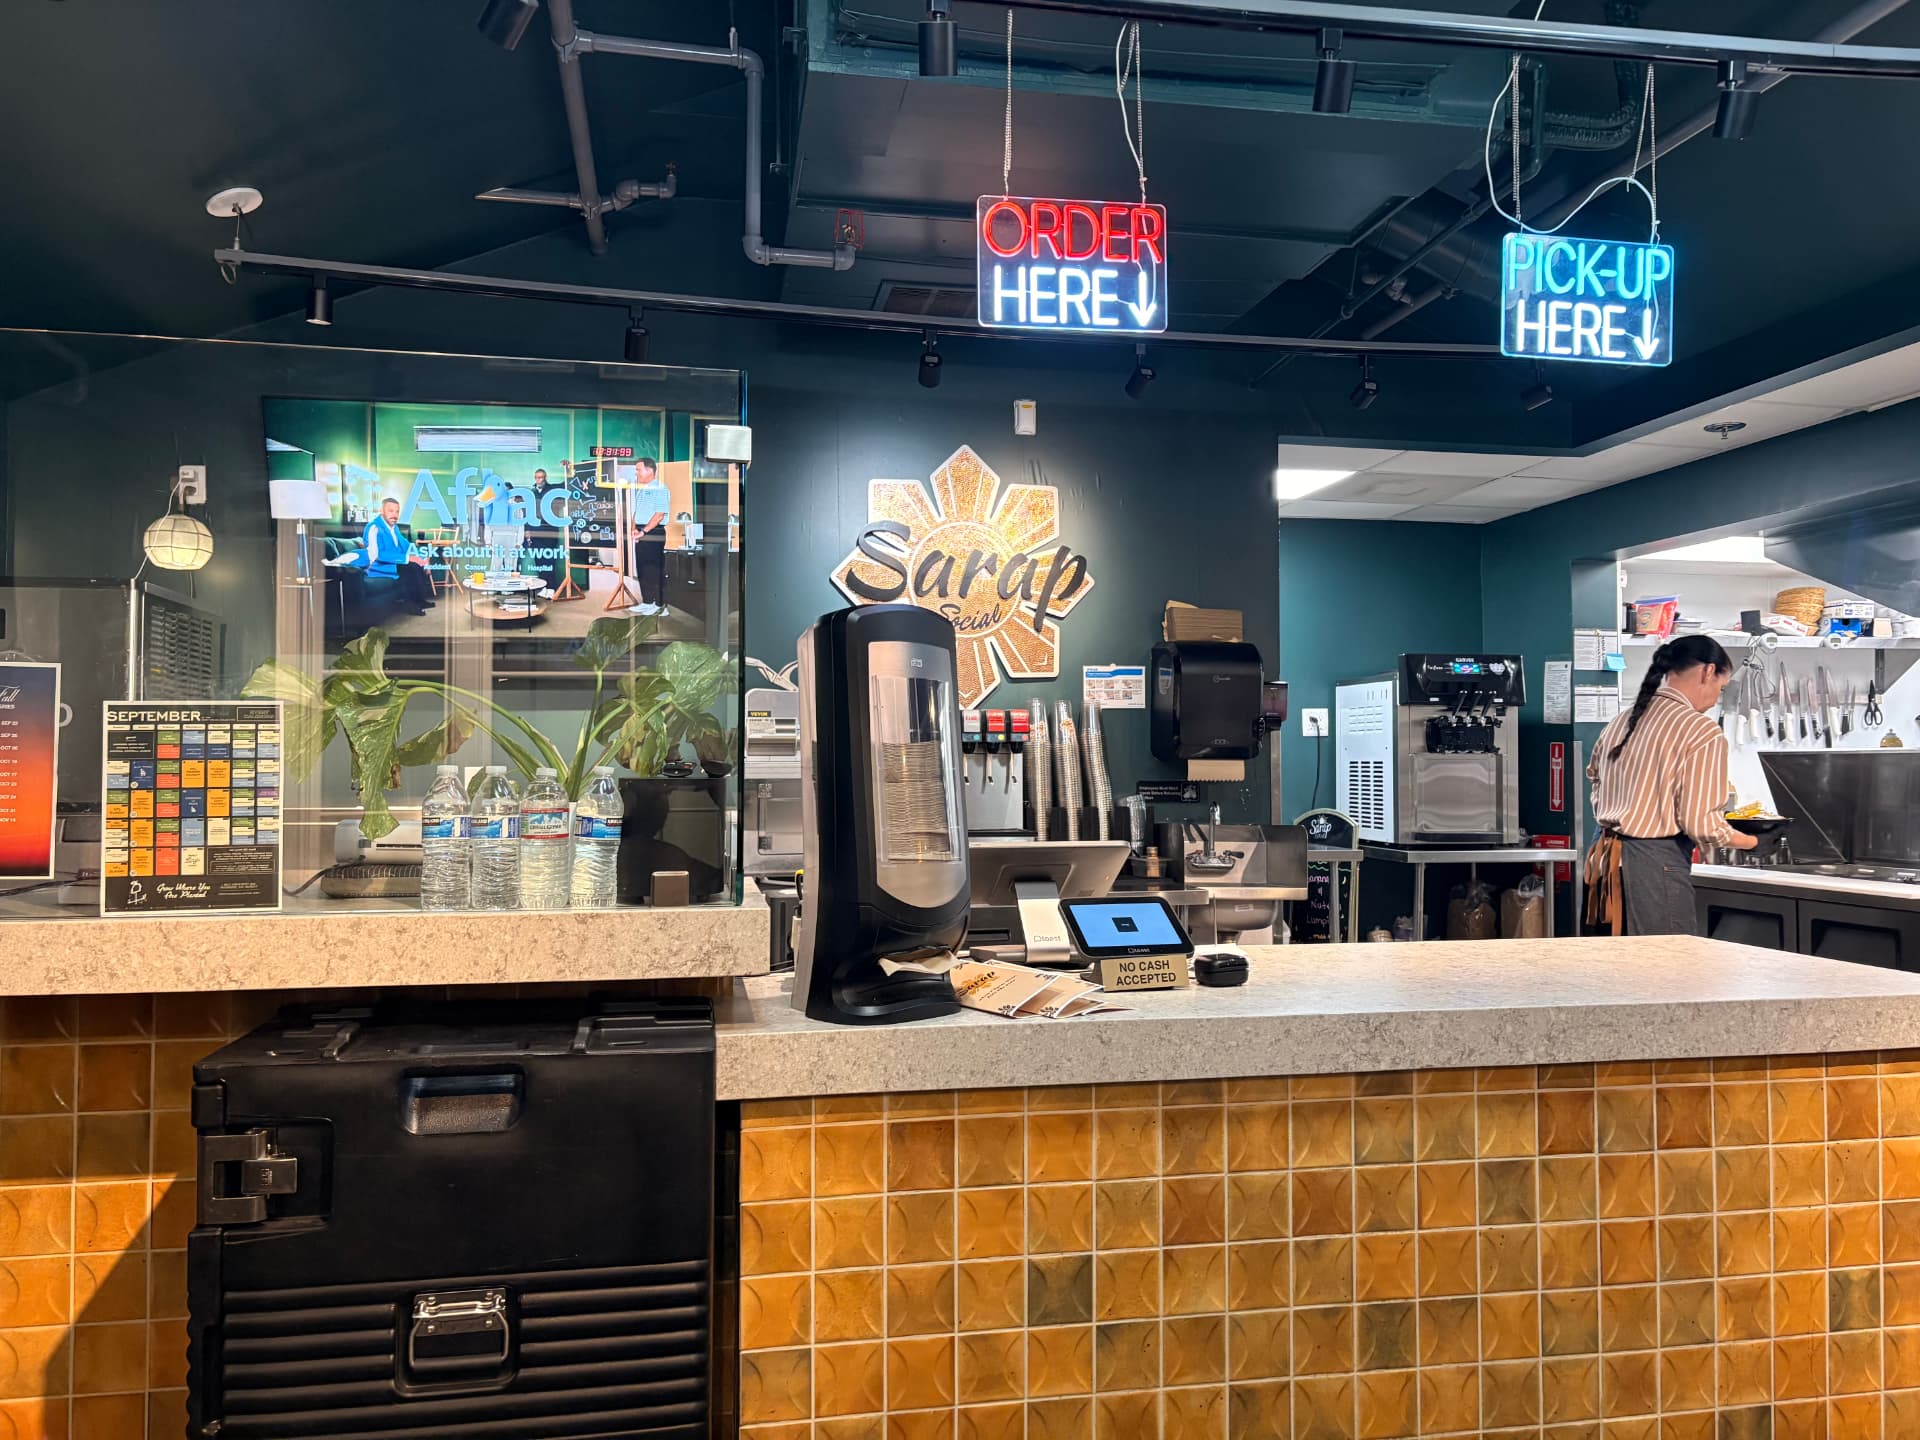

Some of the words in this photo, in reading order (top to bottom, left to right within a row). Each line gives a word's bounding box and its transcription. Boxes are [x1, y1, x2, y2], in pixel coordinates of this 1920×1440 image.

[983, 202, 1163, 264] ORDER
[1507, 237, 1671, 300] PICK-UP
[993, 266, 1119, 326] HERE
[1516, 301, 1627, 359] HERE
[406, 544, 439, 559] Ask
[443, 544, 491, 559] about
[494, 544, 506, 559] it
[510, 546, 526, 559] at
[526, 544, 570, 559] work
[527, 564, 552, 573] Hospital
[846, 519, 1088, 633] Sarap
[940, 602, 1002, 631] Social
[106, 710, 201, 722] SEPTEMBER
[1116, 973, 1176, 986] ACCEPTED
[1119, 962, 1136, 972] NO
[1139, 960, 1170, 971] CASH
